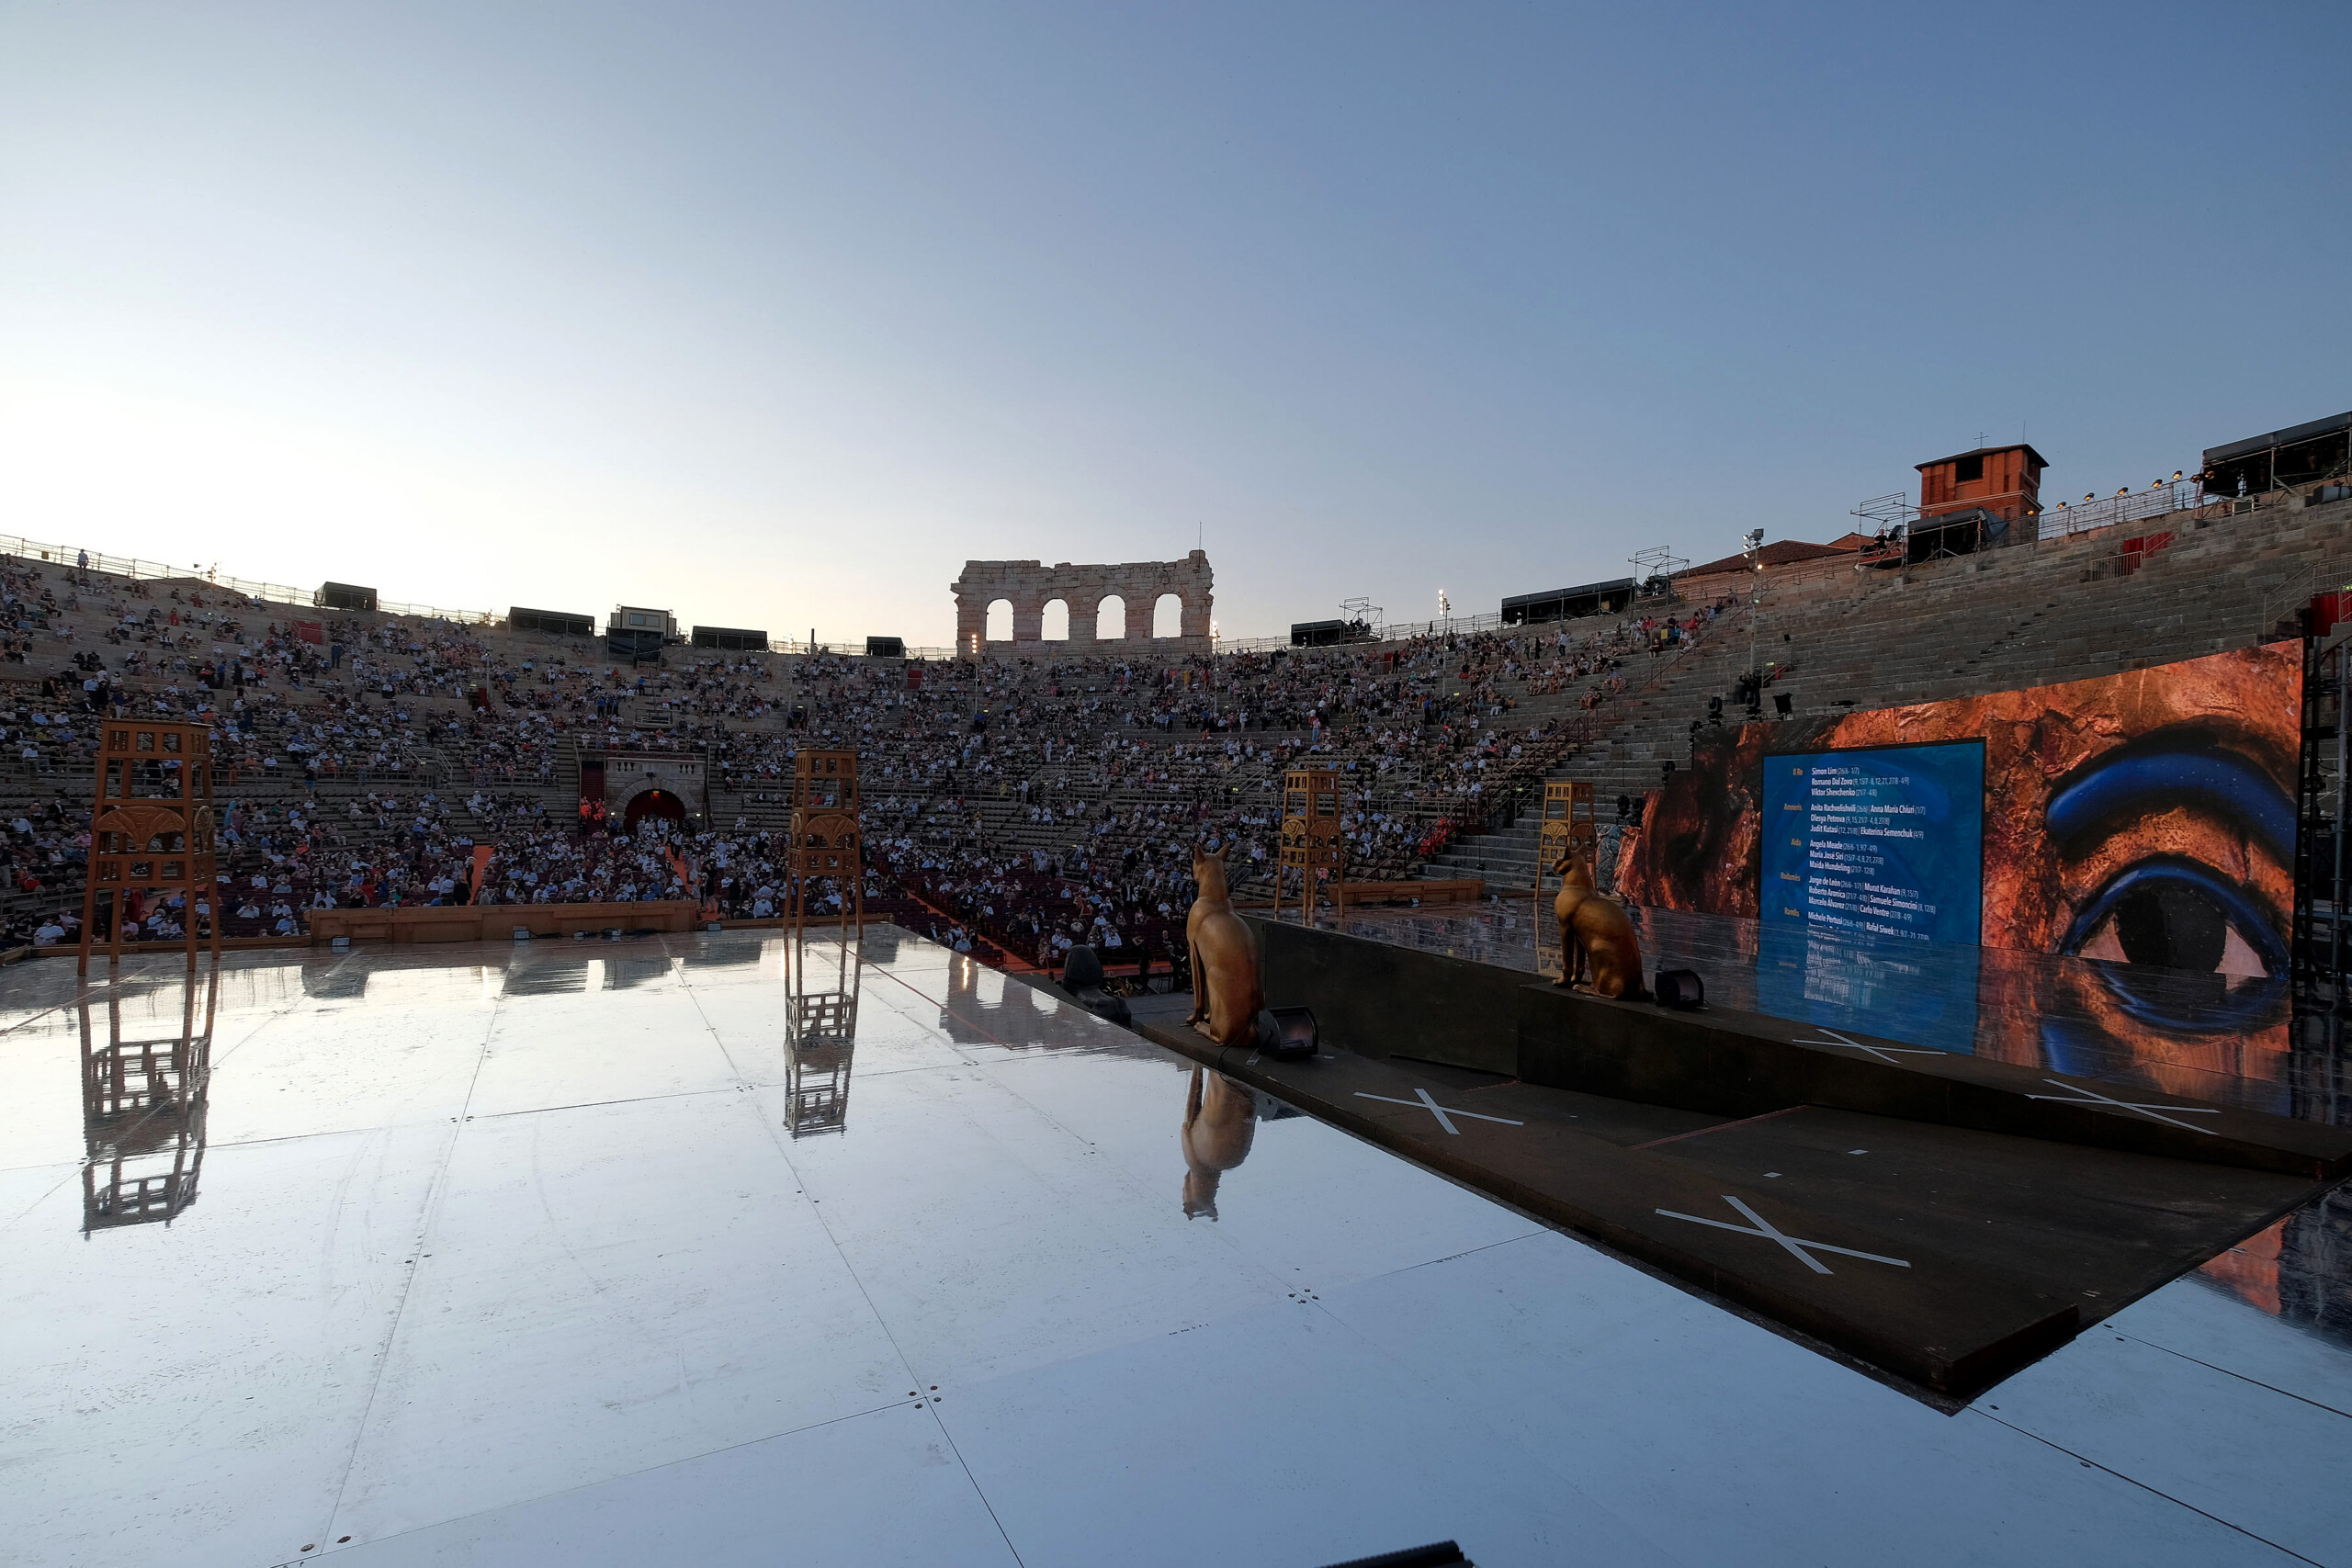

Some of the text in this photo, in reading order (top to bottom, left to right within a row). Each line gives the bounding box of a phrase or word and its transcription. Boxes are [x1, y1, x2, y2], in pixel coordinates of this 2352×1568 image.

[1812, 767, 1826, 775] Simon
[1828, 767, 1837, 775] Lim
[1832, 777, 1840, 785] Dal
[1811, 788, 1826, 796] Viktor
[1826, 788, 1855, 796] Shevchenko
[1811, 804, 1823, 812] Anita
[1824, 804, 1856, 812] Rachvelishvili
[1871, 805, 1883, 813] Anna
[1884, 805, 1898, 814] Maria
[1899, 805, 1914, 814] Chiuri
[1811, 814, 1826, 824] Olesya
[1827, 814, 1845, 823] Petrova
[1824, 825, 1838, 833] Kutasi
[1860, 826, 1883, 836] Ekaterina
[1884, 828, 1913, 838] Semenchuk
[1810, 840, 1826, 850] Angela
[1826, 840, 1843, 850] Meade
[1810, 861, 1824, 870] Maida
[1825, 862, 1850, 874] Hundeling
[1809, 875, 1822, 886] Jorge
[1865, 883, 1879, 892] Murat
[1880, 884, 1900, 895] Karahan
[1809, 886, 1826, 896] Roberto
[1827, 888, 1845, 898] Aronica
[1871, 895, 1891, 906] Samuele
[1893, 898, 1917, 910] Simoncini
[1809, 897, 1826, 907] Marcelo
[1860, 904, 1872, 914] Carlo
[1873, 907, 1889, 917] Ventre
[1808, 911, 1826, 921] Michele
[1826, 915, 1842, 925] Pertusi
[1879, 924, 1894, 935] Siwek
